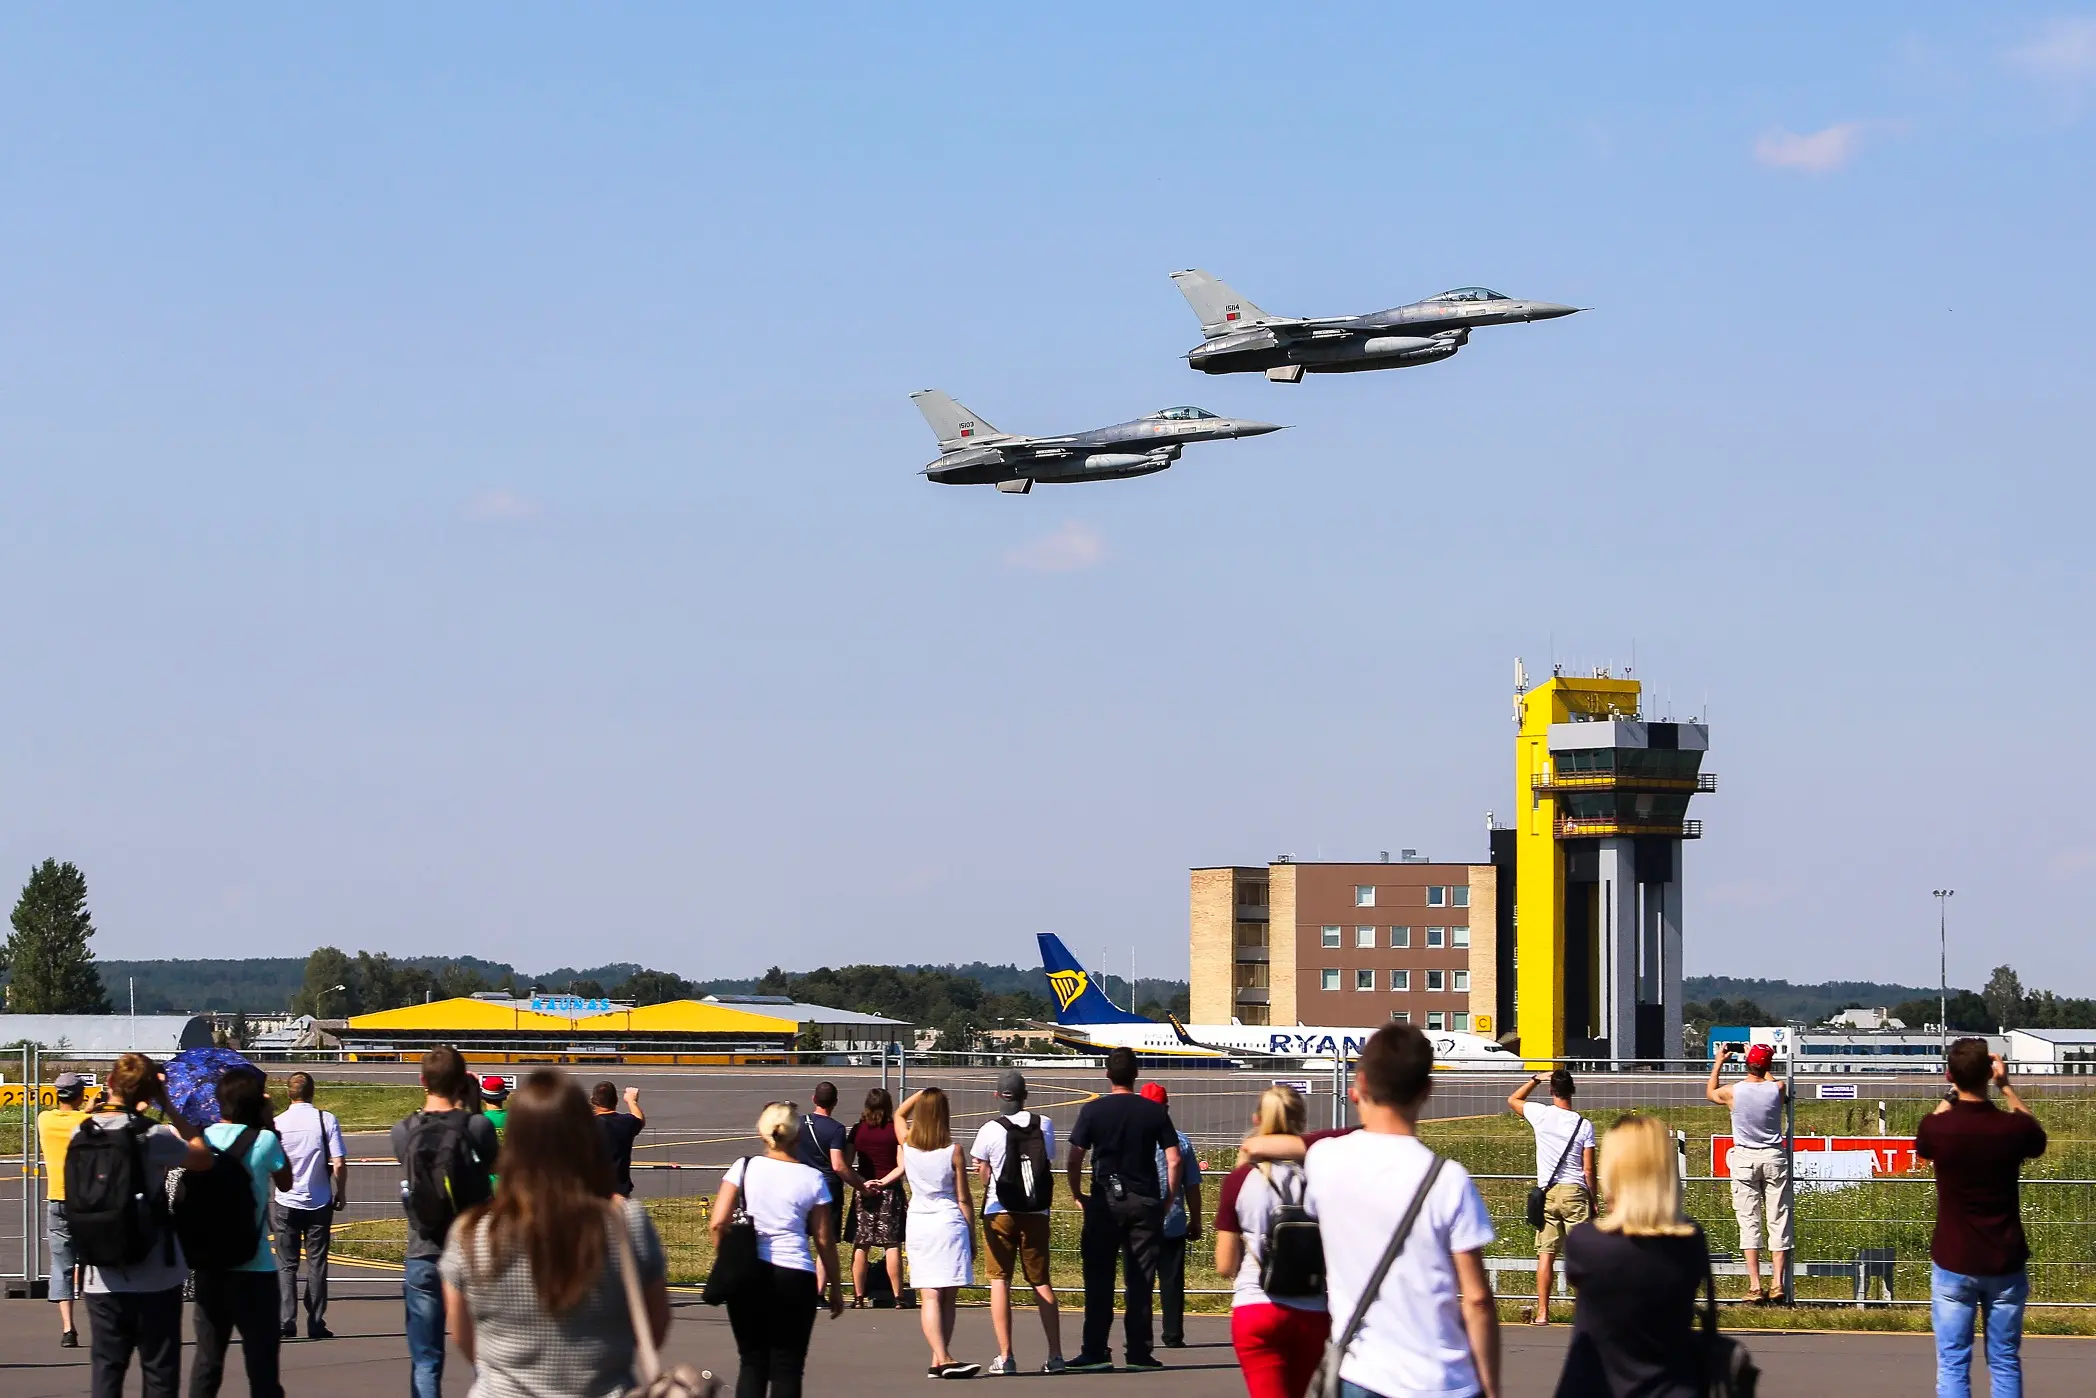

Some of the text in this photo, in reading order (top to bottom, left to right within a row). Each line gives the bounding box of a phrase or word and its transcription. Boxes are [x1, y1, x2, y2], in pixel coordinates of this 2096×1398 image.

[531, 997, 610, 1011] KAUNAS
[1478, 1017, 1488, 1028] C
[1270, 1034, 1366, 1055] RYAN
